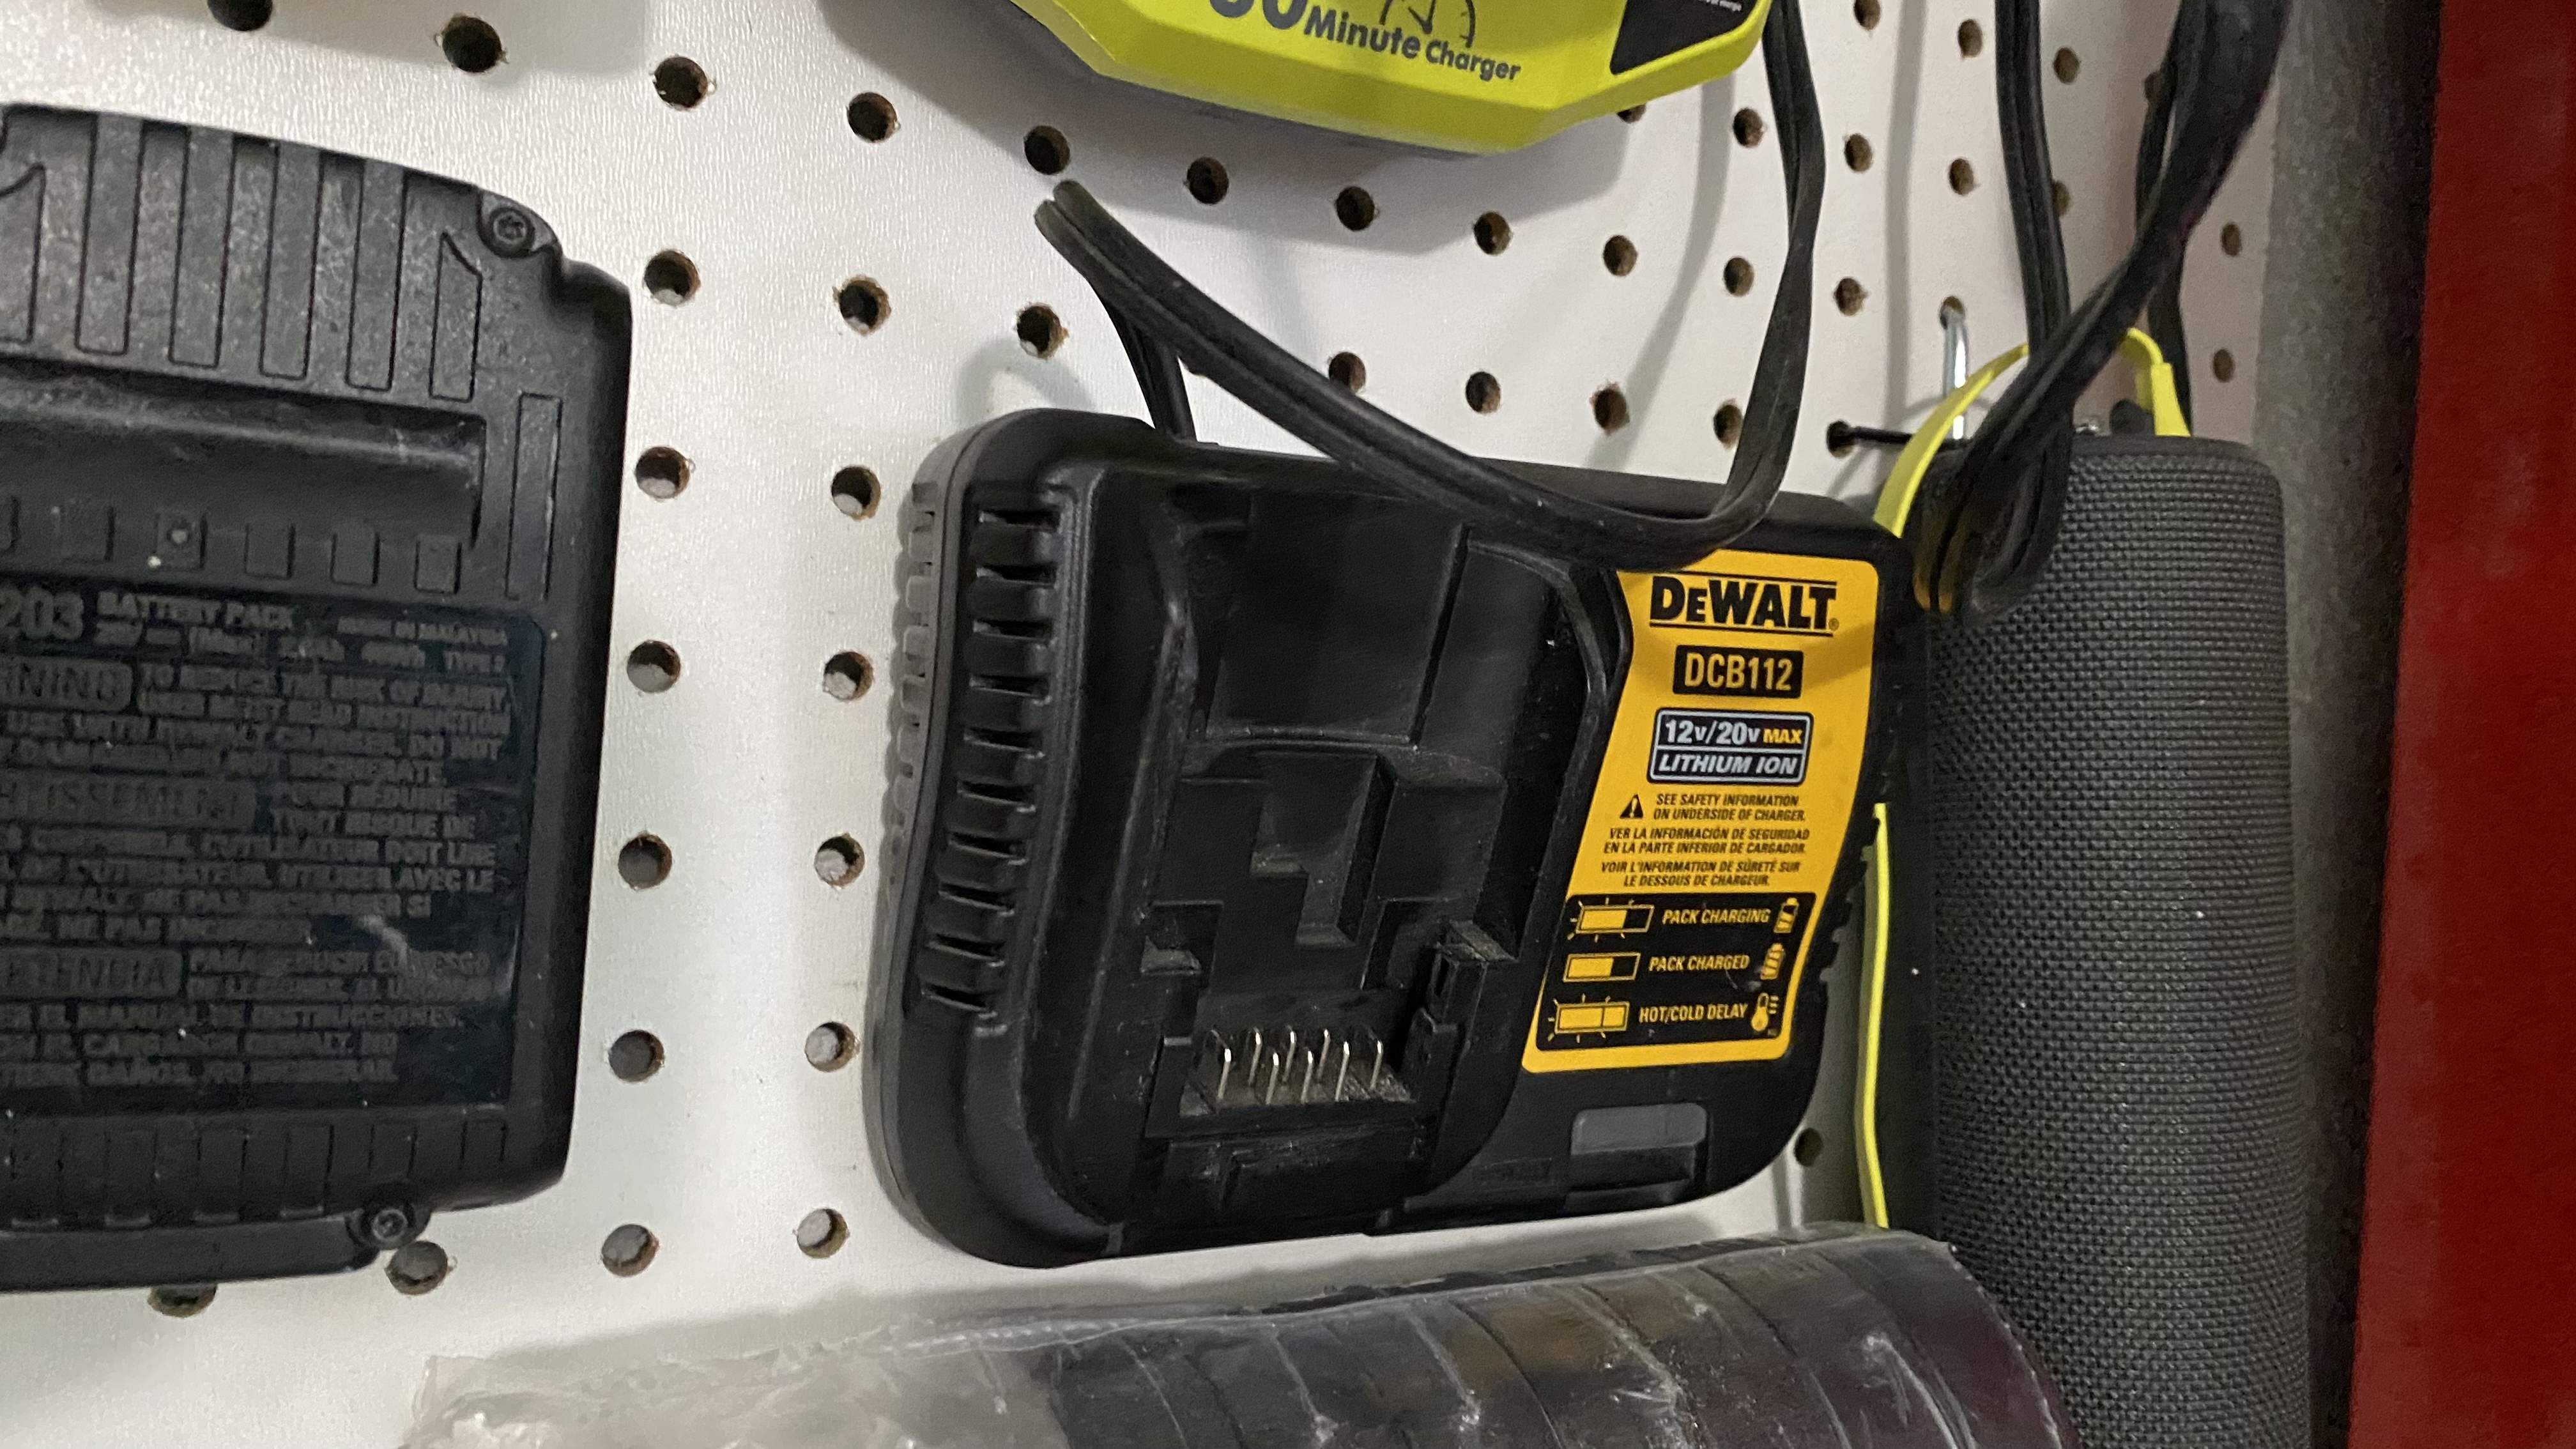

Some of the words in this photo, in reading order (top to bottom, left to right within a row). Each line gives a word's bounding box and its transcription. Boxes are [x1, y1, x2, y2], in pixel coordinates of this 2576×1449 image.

[1303, 6, 1421, 59] Minute
[1425, 39, 1522, 82] Charger
[226, 602, 294, 629] PACK
[1685, 652, 1793, 691] DCB112
[1763, 728, 1802, 744] MAX
[1660, 753, 1753, 774] LITHIUM
[1756, 756, 1798, 776] ION
[1656, 793, 1677, 805] SEE
[1680, 793, 1721, 806] SAFETY
[1723, 794, 1799, 806] INFORMATION
[1653, 808, 1670, 820] ON
[1673, 809, 1736, 820] UNDERSIDE
[1738, 809, 1753, 820] OF
[1610, 827, 1630, 839] VER
[1633, 827, 1647, 839] LA
[1731, 828, 1745, 839] DE
[1748, 829, 1811, 841] SEGURIDAD
[1604, 841, 1620, 854] EN
[1622, 841, 1636, 854] LA
[1639, 841, 1674, 854] PARTE
[1676, 842, 1728, 854] INFERIOR
[1729, 842, 1744, 854] DE
[1601, 861, 1627, 873] VOIR
[1721, 861, 1734, 873] DE
[1779, 861, 1800, 873] SUR
[397, 866, 461, 893] AVEC
[1623, 875, 1637, 886] LE
[1639, 875, 1690, 887] DESSOUS
[1693, 875, 1708, 887] DE
[1662, 909, 1698, 925] PACK
[1701, 907, 1771, 924] CHARGING
[1649, 956, 1685, 972] PACK
[1688, 954, 1751, 971] CHARGED
[1638, 1006, 1705, 1024] HOT/COLD
[1706, 1004, 1749, 1021] DELAY
